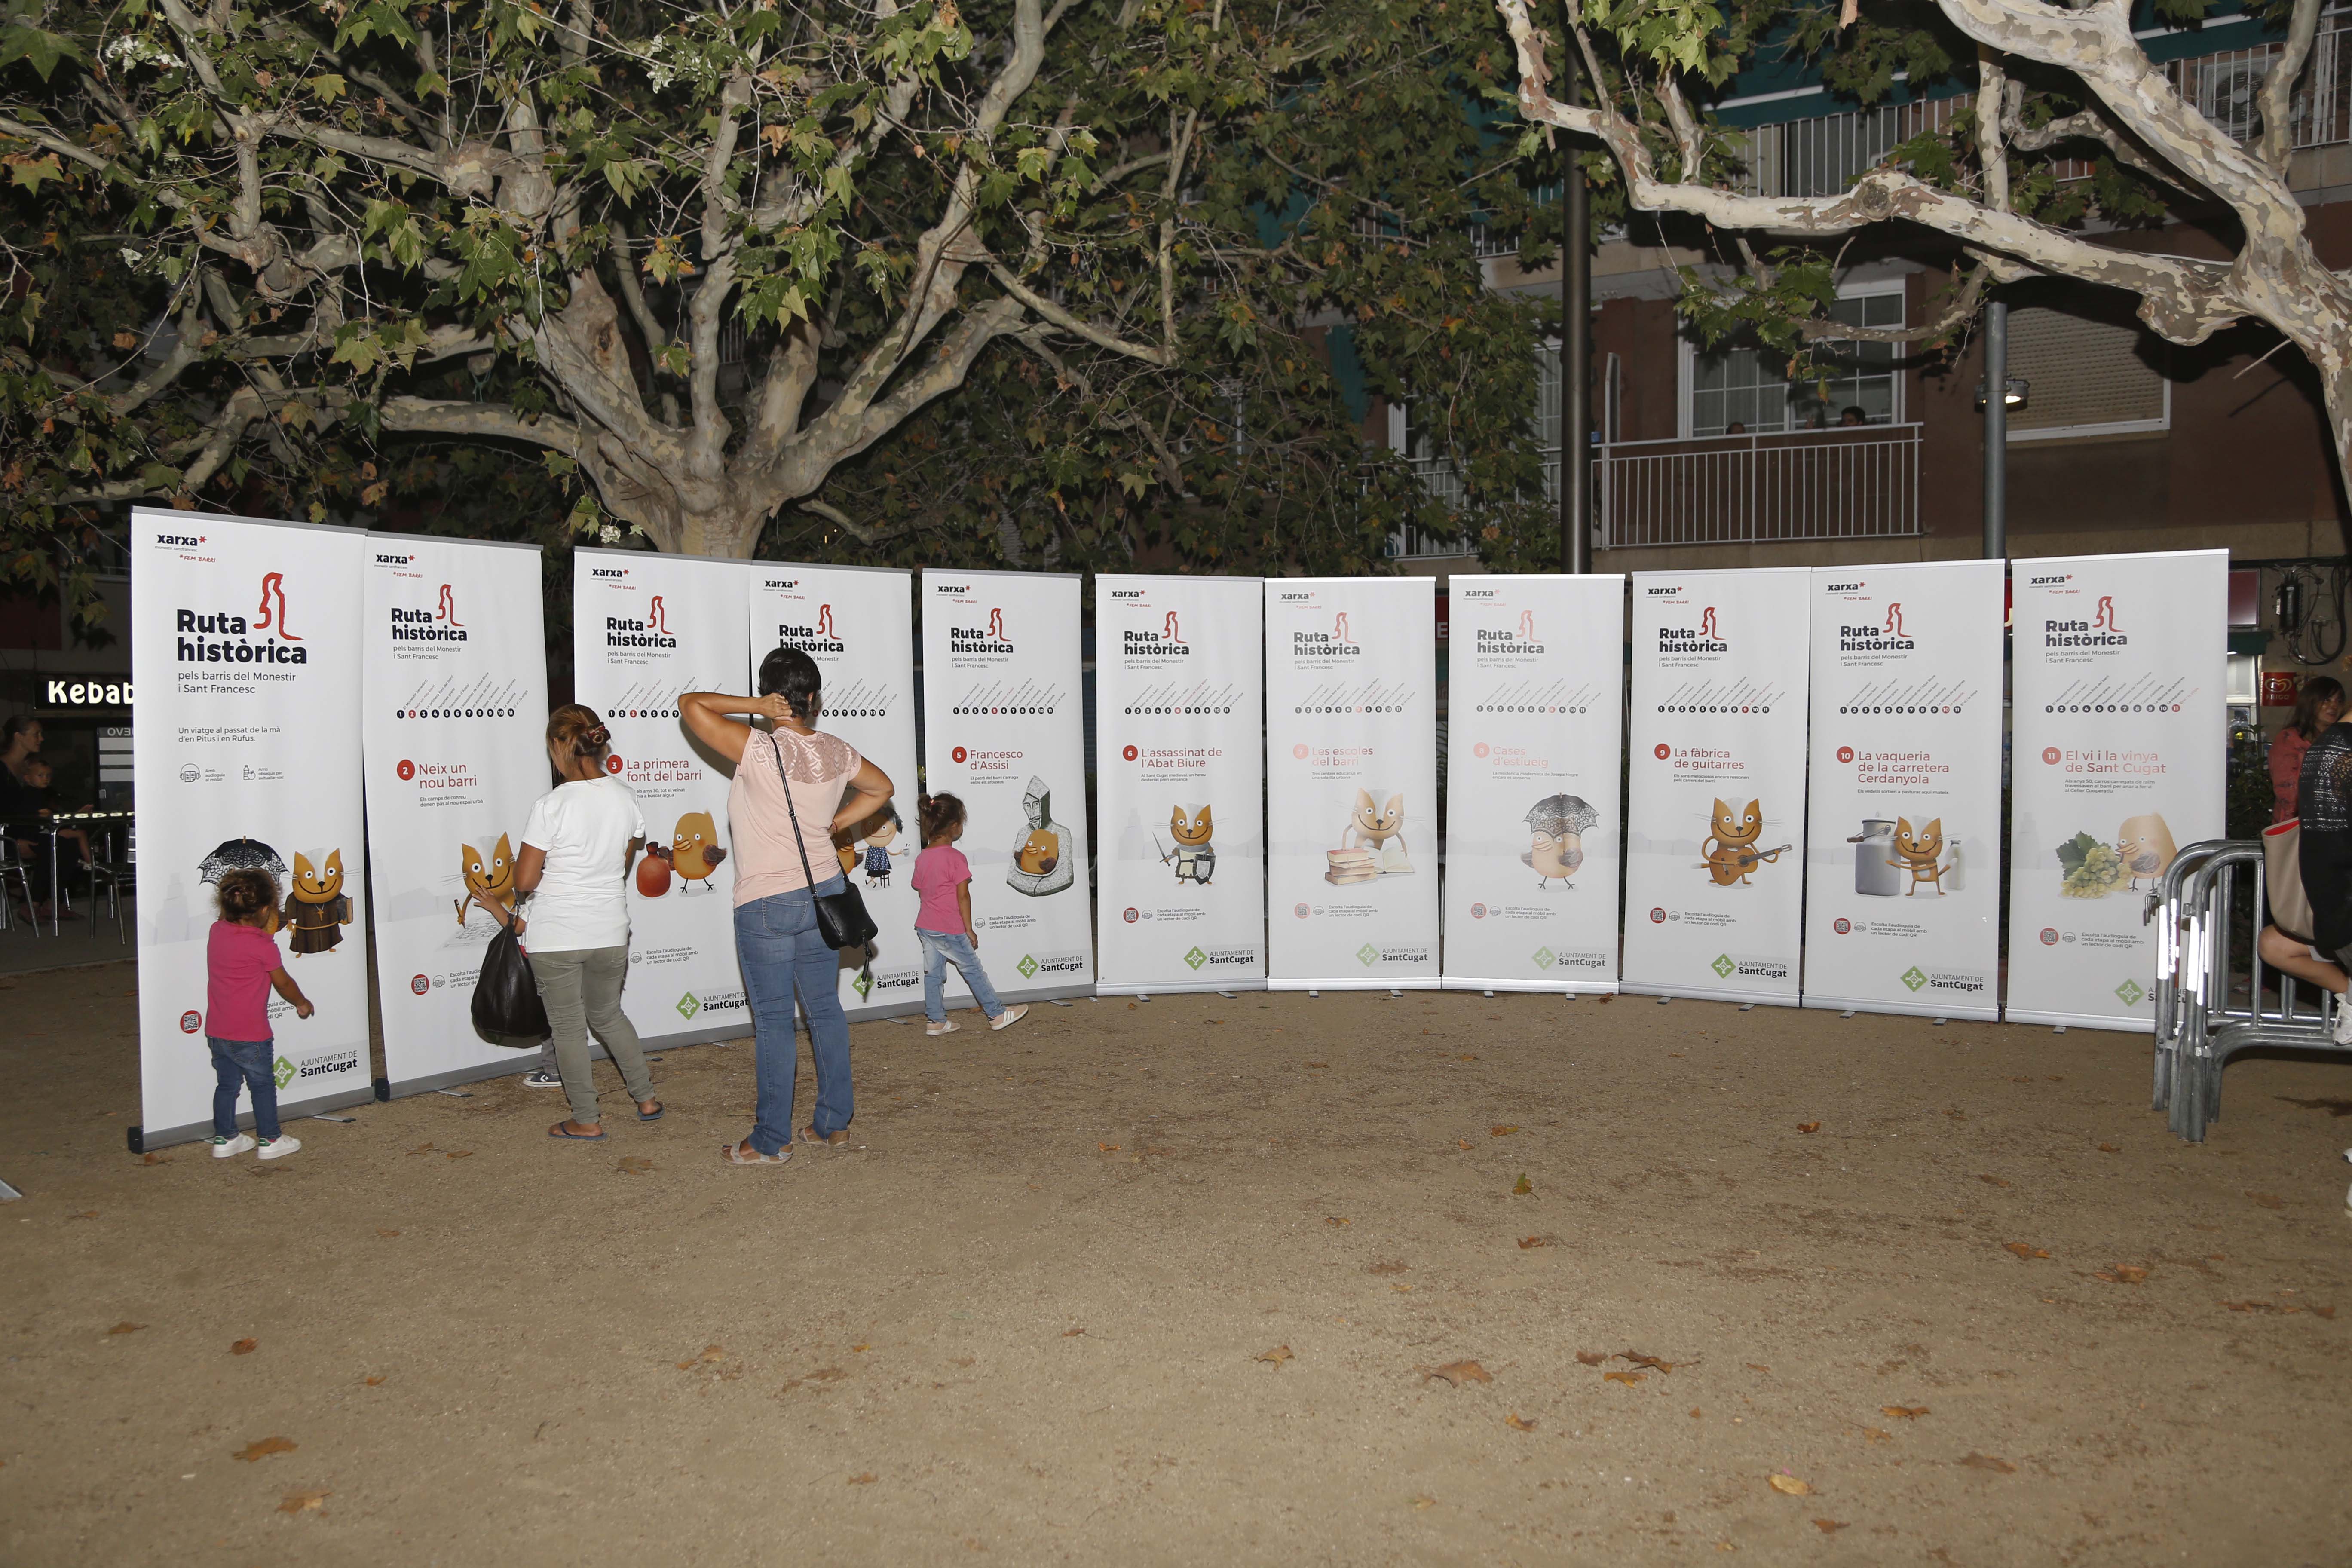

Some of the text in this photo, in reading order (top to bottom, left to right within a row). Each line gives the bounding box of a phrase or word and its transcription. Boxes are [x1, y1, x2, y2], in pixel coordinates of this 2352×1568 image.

[177, 609, 246, 634] Ruta
[391, 608, 432, 623] Ruta
[607, 617, 644, 631] Ruta
[2046, 620, 2088, 632] Ruta
[392, 624, 467, 641] històrica
[779, 625, 813, 637] Ruta
[951, 627, 984, 639] Ruta
[1124, 631, 1158, 642] Ruta
[1477, 629, 1513, 640] Ruta
[1659, 628, 1695, 639] Ruta
[1841, 625, 1879, 637] Ruta
[607, 631, 676, 648] històrica
[1294, 632, 1329, 643] Ruta
[2046, 631, 2127, 647] històrica
[178, 635, 307, 664] històrica
[951, 639, 1014, 653] històrica
[1124, 642, 1189, 655] històrica
[1294, 643, 1360, 655] històrica
[1477, 641, 1544, 654] històrica
[1659, 639, 1727, 652] històrica
[1841, 637, 1914, 651] històrica
[178, 671, 296, 682] pels barris del Monestir
[48, 680, 134, 704] Kebab
[178, 683, 255, 693] i Sant Francesc
[190, 727, 214, 736] viatge
[970, 750, 1023, 759] Francesco
[1142, 747, 1222, 757] L'assassinat de
[1493, 746, 1526, 756] Cases
[1675, 748, 1730, 758] La fàbrica
[1859, 751, 1930, 763] La vaqueria
[2066, 750, 2159, 764] El vi i la vinya
[627, 758, 689, 772] La primera
[970, 760, 1008, 770] d'Assisi
[1142, 758, 1206, 768] l'Abat Biure
[1312, 756, 1359, 766] del barri
[1493, 756, 1548, 769] d'estiueig
[1674, 758, 1744, 771] de guitarres
[419, 762, 466, 775] Neix un
[1858, 762, 1949, 773] de la carretera
[2065, 762, 2167, 776] de Sant Cugat
[420, 774, 477, 789] nou barri
[626, 769, 701, 782] font del barri
[1858, 773, 1929, 786] Cerdanyola
[1041, 956, 1075, 964] AJUNTAMENT
[1210, 956, 1254, 965] SantCugat
[1382, 954, 1428, 962] SantCugat
[1559, 958, 1606, 968] SantCugat
[1041, 961, 1083, 972] SantCugat
[1738, 961, 1778, 969] AJUNTAMENT
[877, 971, 910, 980] AJUNTAMENT
[1738, 966, 1787, 978] SantCugat
[1931, 973, 1974, 982] AJUNTAMENT
[877, 977, 919, 989] SantCugat
[1930, 979, 1983, 992] SantCugat
[703, 992, 740, 1002] AJUNTAMENT
[703, 997, 749, 1011] SantCugat
[300, 1050, 357, 1067] AJUNTAMENT DE
[300, 1058, 357, 1077] SantCugat
